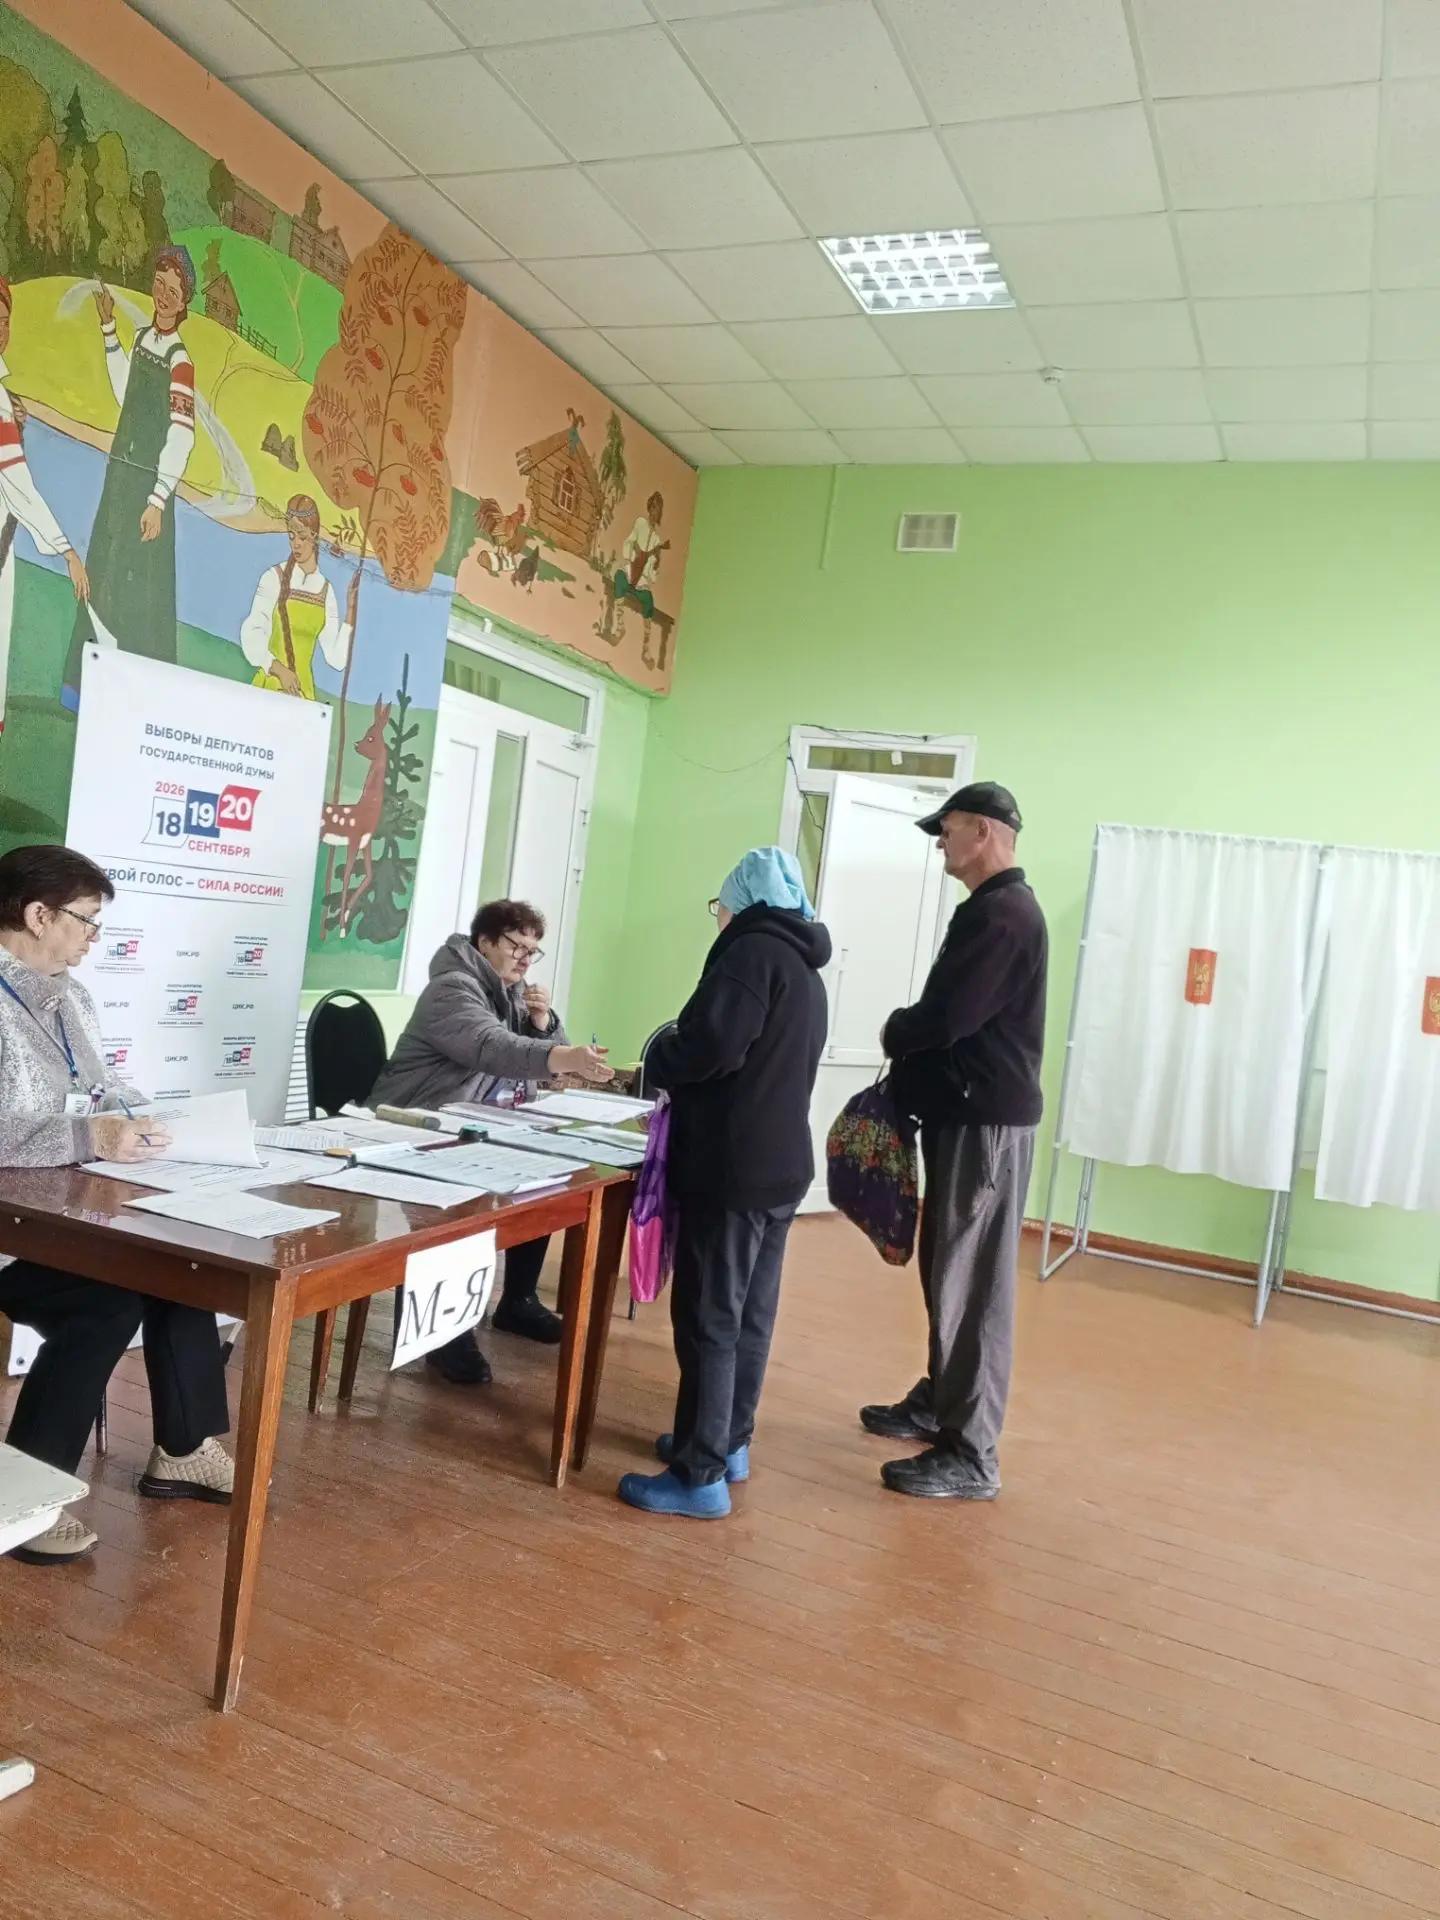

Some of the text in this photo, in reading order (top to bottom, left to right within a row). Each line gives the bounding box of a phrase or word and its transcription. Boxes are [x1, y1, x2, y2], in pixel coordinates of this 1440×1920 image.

[144, 723, 274, 761] ВЫБОРЫ ДЕПУТАТОВ
[139, 744, 274, 780] ГОСУДАРСТВЕННОЙ ДУМЫ
[155, 781, 185, 796] 2026
[155, 796, 252, 837] 18 19 20
[188, 840, 250, 858] СЕНТЯБРЯ
[104, 867, 136, 882] ВОЙ
[140, 871, 182, 886] ГОЛОС
[198, 878, 230, 892] СИЛА
[233, 881, 284, 897] РОССИИ!
[187, 998, 196, 1006] 20
[400, 1264, 492, 1349] М-Я
